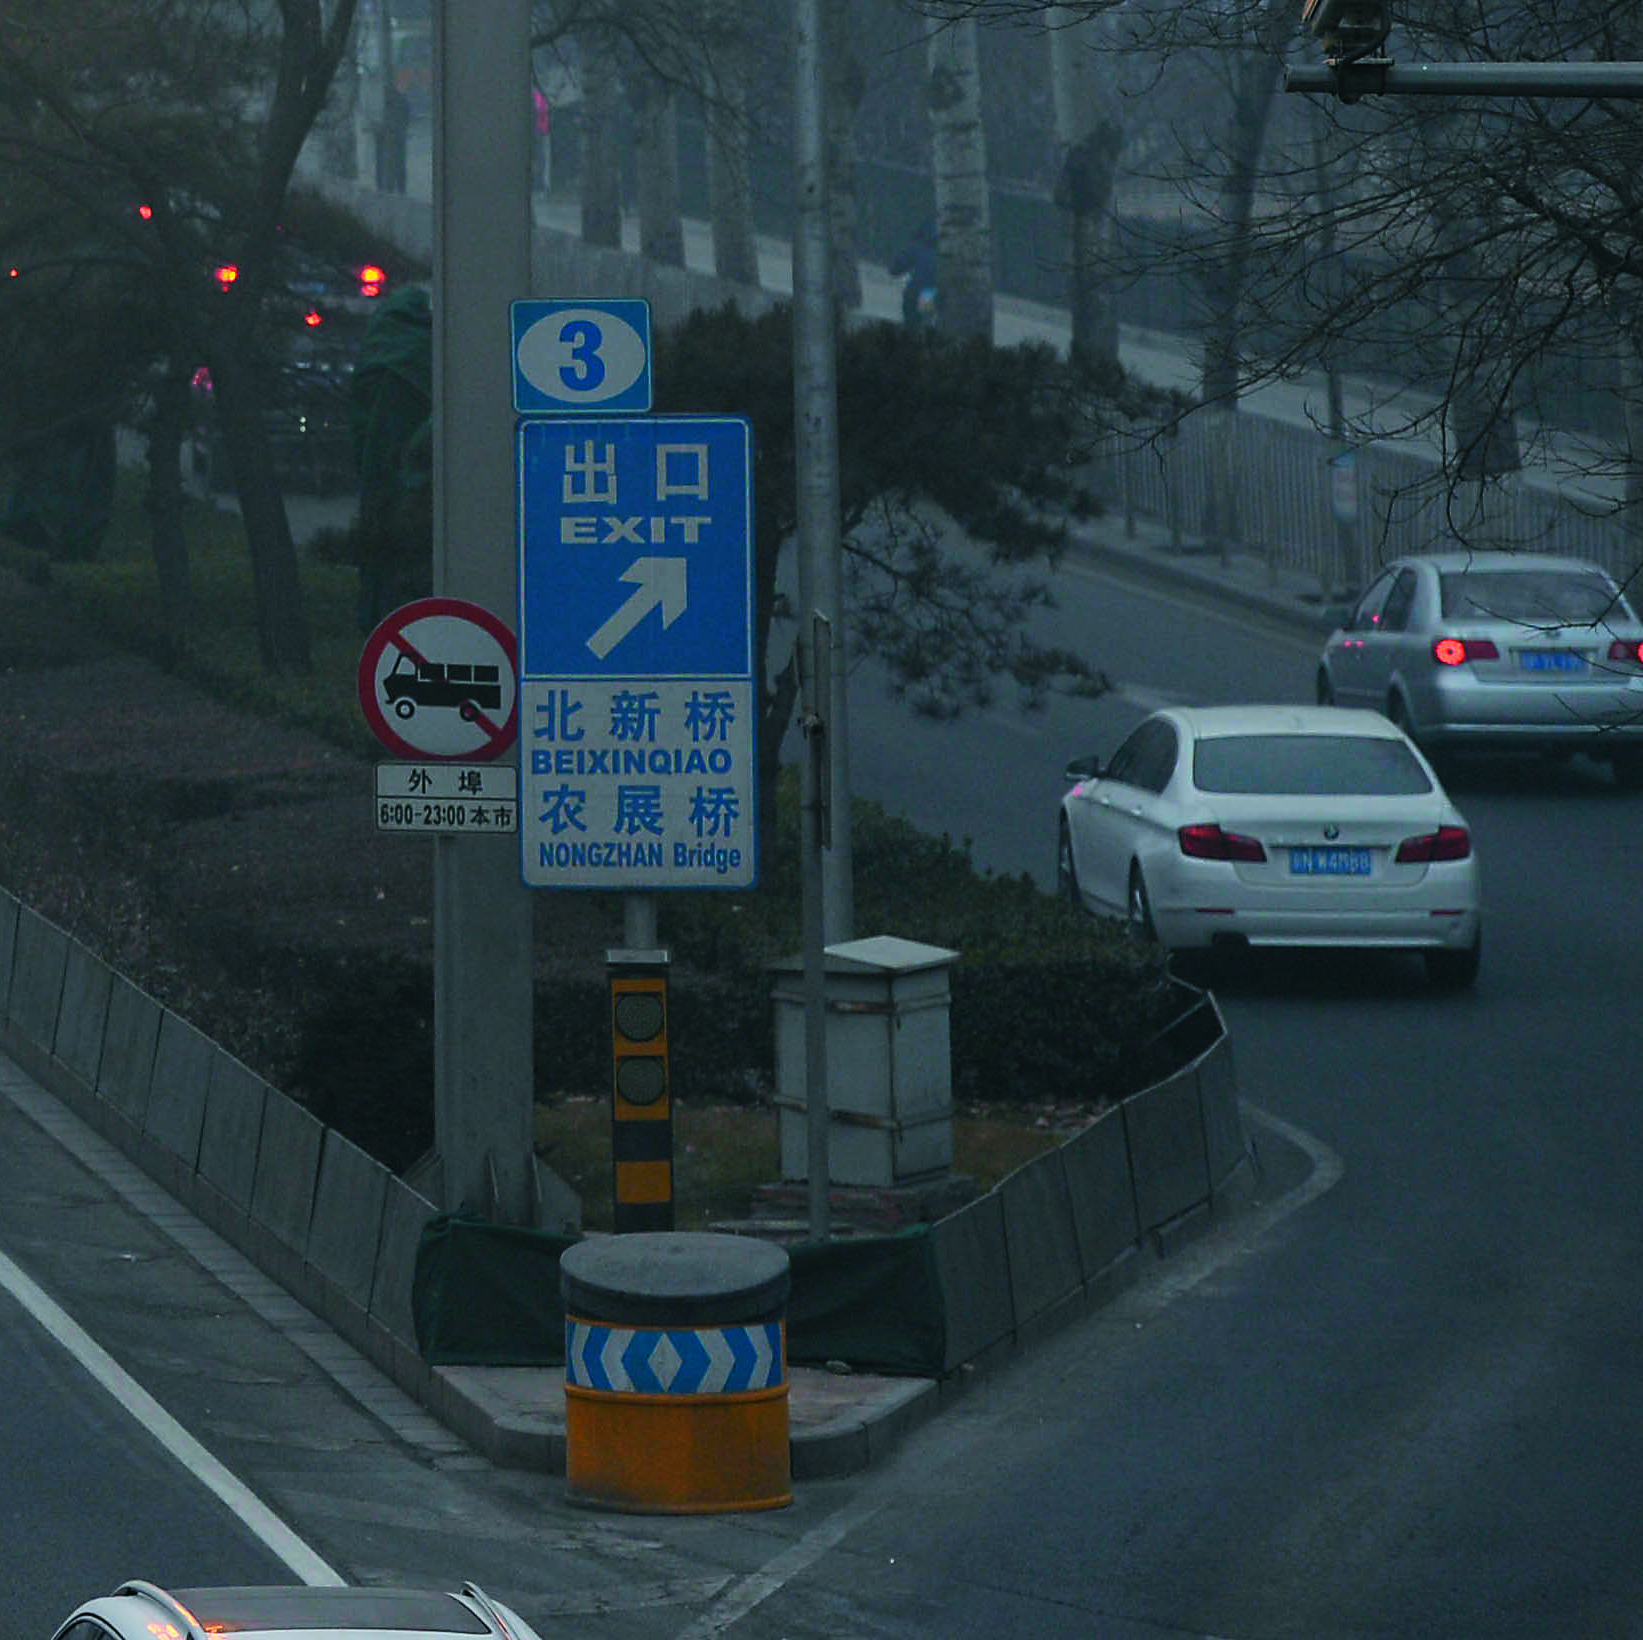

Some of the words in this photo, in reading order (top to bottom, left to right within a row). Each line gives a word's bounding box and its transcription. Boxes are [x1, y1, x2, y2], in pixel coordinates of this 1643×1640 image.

[559, 320, 606, 391] 3
[563, 440, 709, 504] 出口
[560, 516, 712, 545] EXIT
[532, 689, 736, 742] 北新桥
[408, 767, 484, 795] 外埠
[531, 748, 732, 776] BEIXINQIAO
[538, 784, 740, 838] 农展桥
[539, 842, 663, 867] NONGZHAN
[673, 842, 742, 874] Bridge
